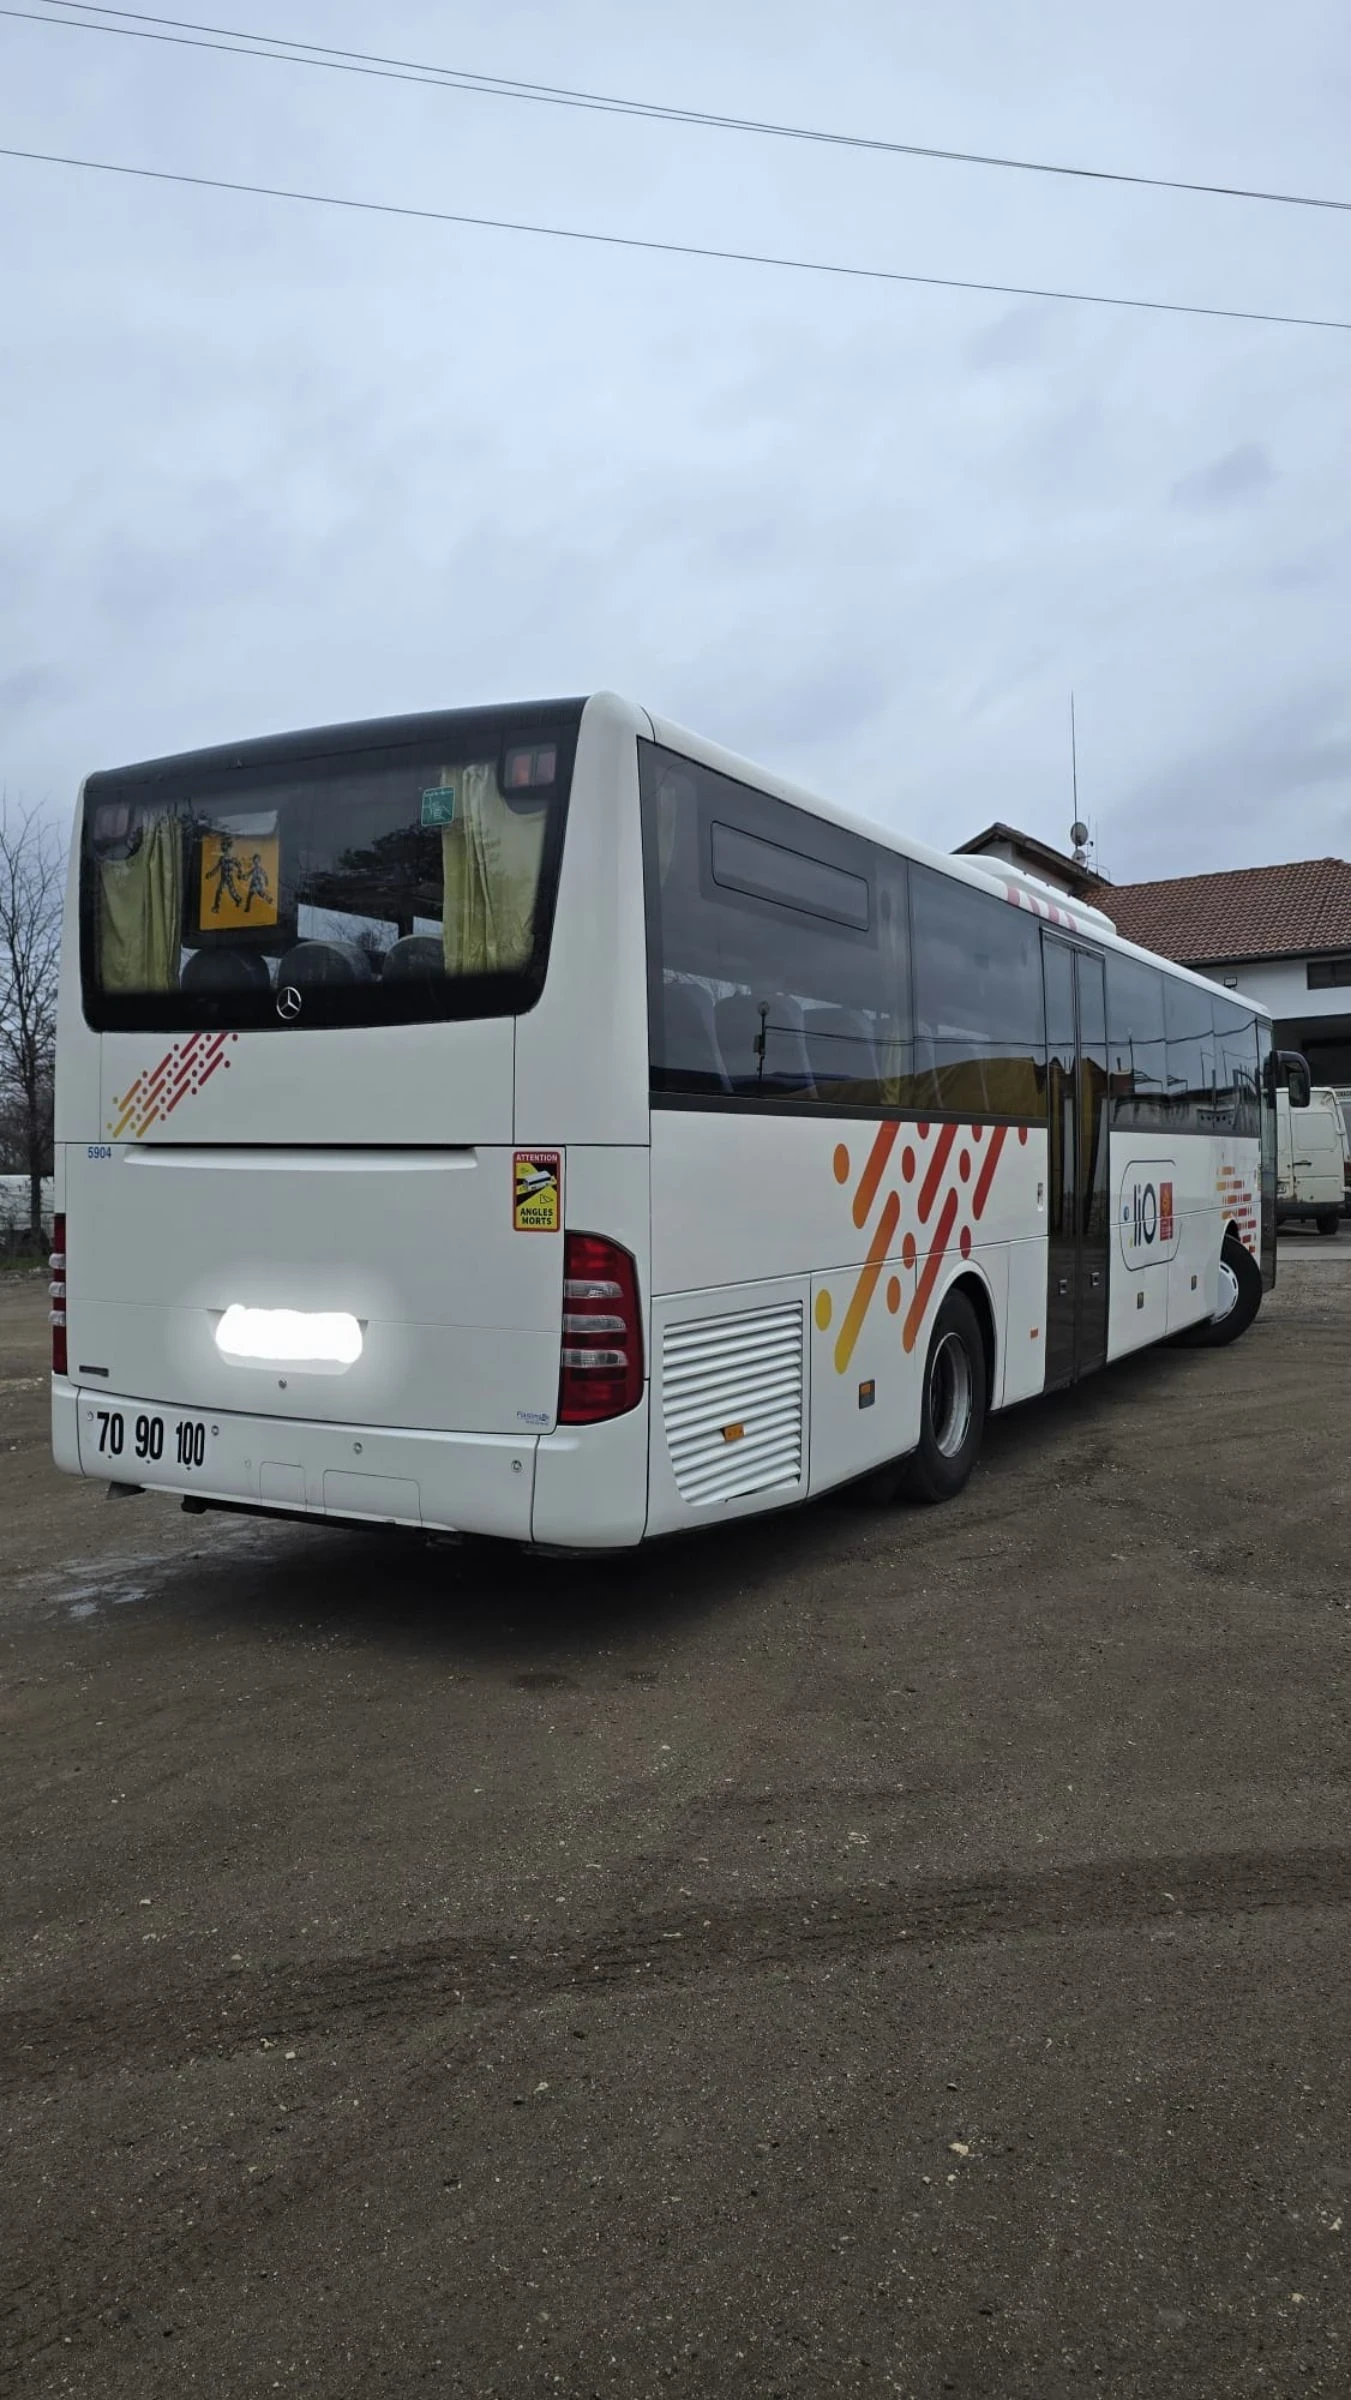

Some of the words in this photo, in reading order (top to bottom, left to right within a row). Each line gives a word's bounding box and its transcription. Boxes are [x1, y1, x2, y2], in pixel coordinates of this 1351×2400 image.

[88, 1146, 112, 1159] 5904
[516, 1153, 558, 1161] ATTENTION
[520, 1208, 553, 1217] ANGLES
[521, 1217, 552, 1225] MORTS
[97, 1412, 124, 1456] 70
[135, 1415, 164, 1460] 90
[176, 1421, 205, 1467] 100
